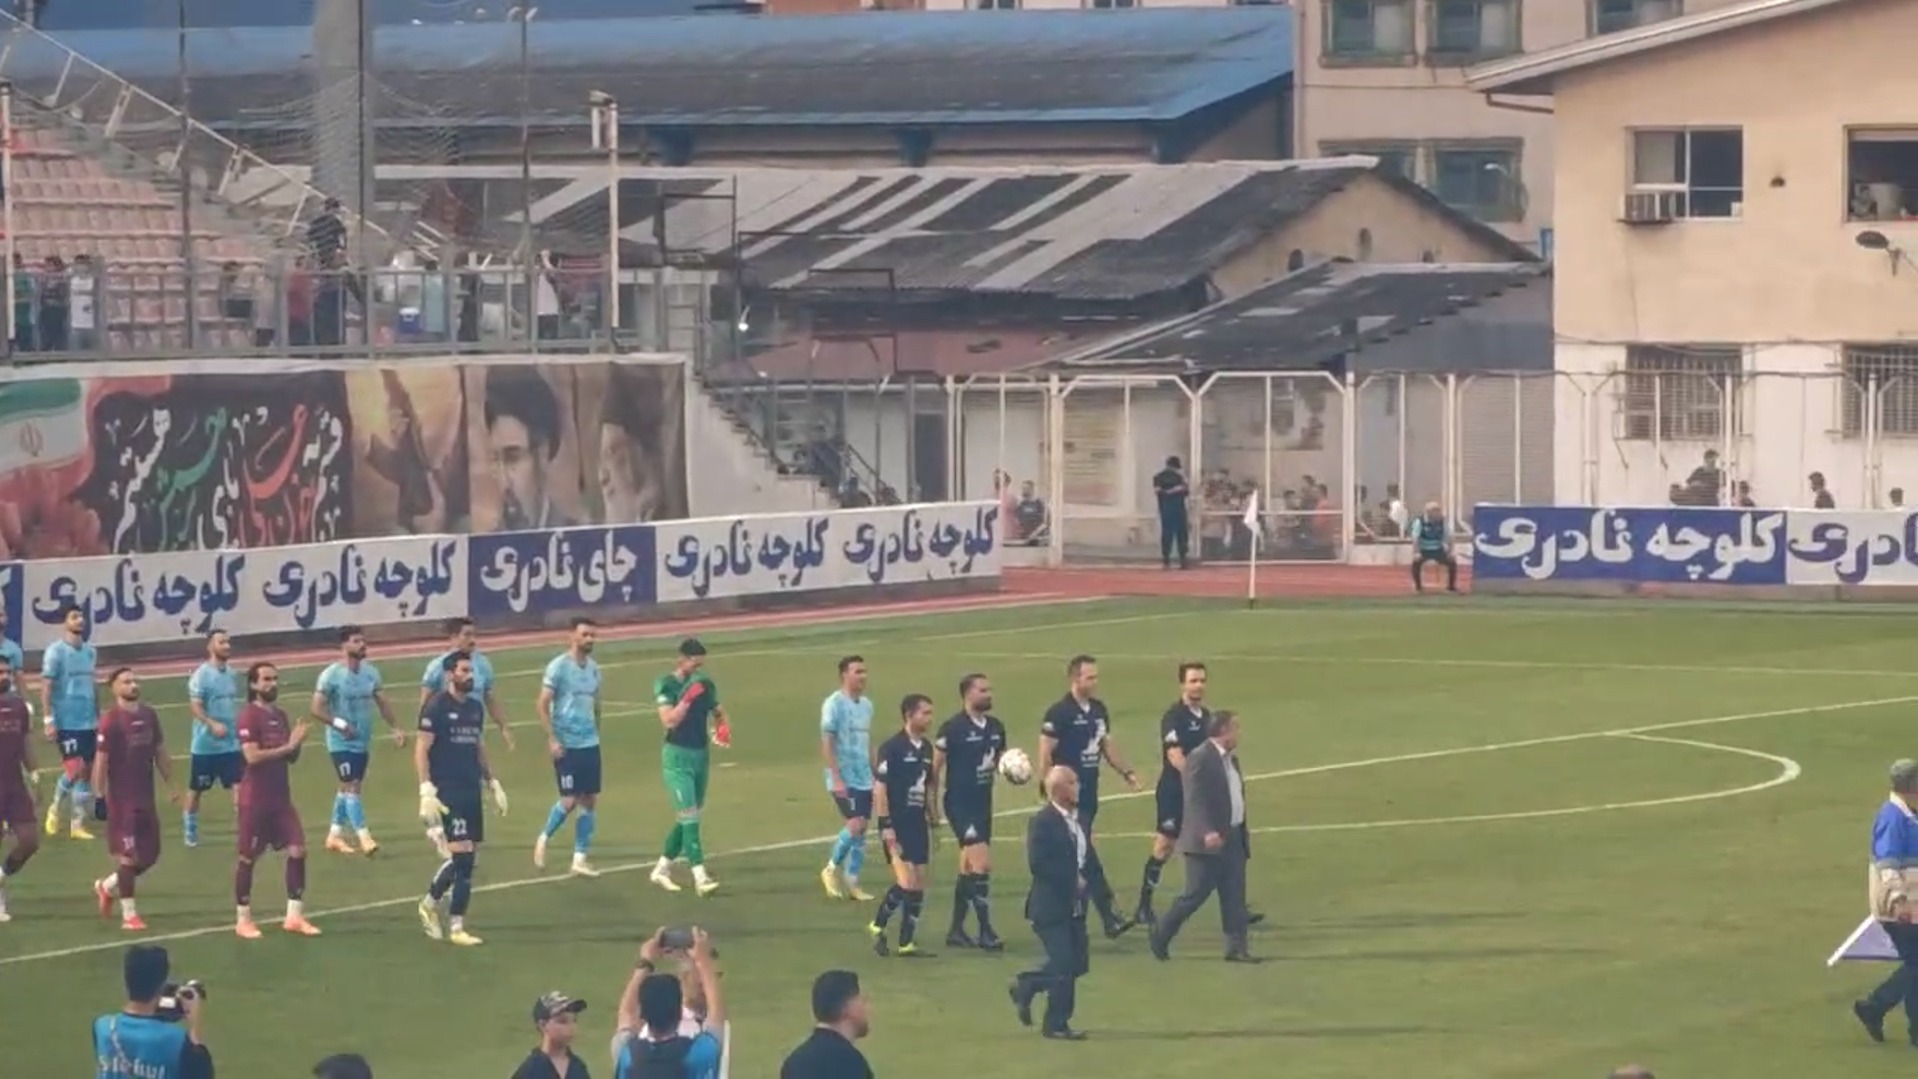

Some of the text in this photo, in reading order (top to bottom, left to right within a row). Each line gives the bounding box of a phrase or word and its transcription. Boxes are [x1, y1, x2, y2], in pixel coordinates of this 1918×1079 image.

[480, 530, 637, 612] چای نادری
[665, 516, 829, 597] کلوچه نادری
[843, 506, 998, 584] کلوچه نادری
[1475, 509, 1783, 581] کلوچه نادری
[1788, 512, 1918, 584] ادری
[153, 554, 245, 634] کلوچه
[263, 541, 456, 638] کلوچه نادری
